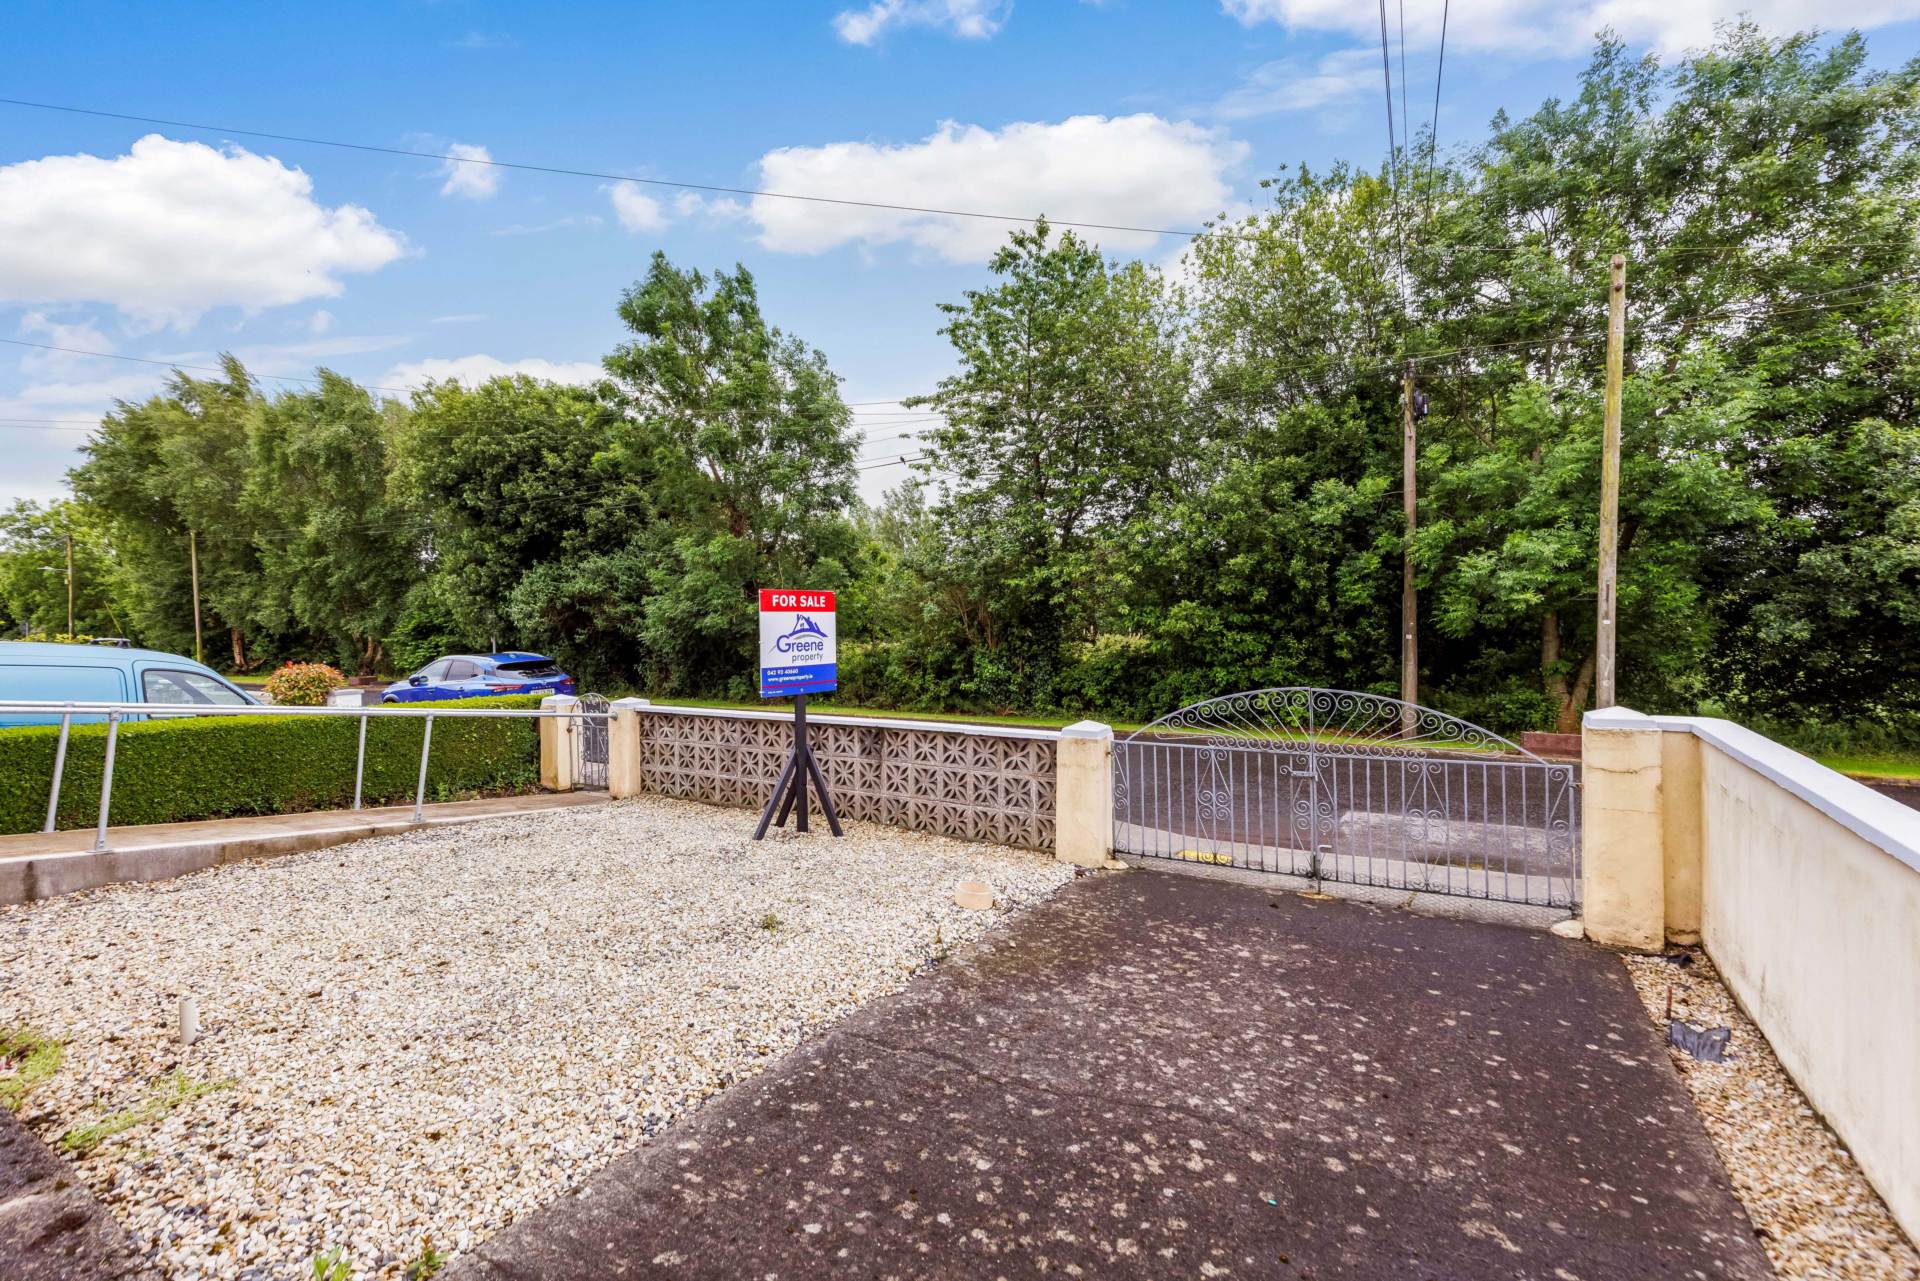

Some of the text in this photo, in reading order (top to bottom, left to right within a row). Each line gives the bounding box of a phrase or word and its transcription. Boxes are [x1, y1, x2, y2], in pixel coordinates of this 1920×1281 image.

[772, 594, 826, 607] FOR SALE
[776, 634, 824, 653] Greene
[792, 652, 823, 663] property
